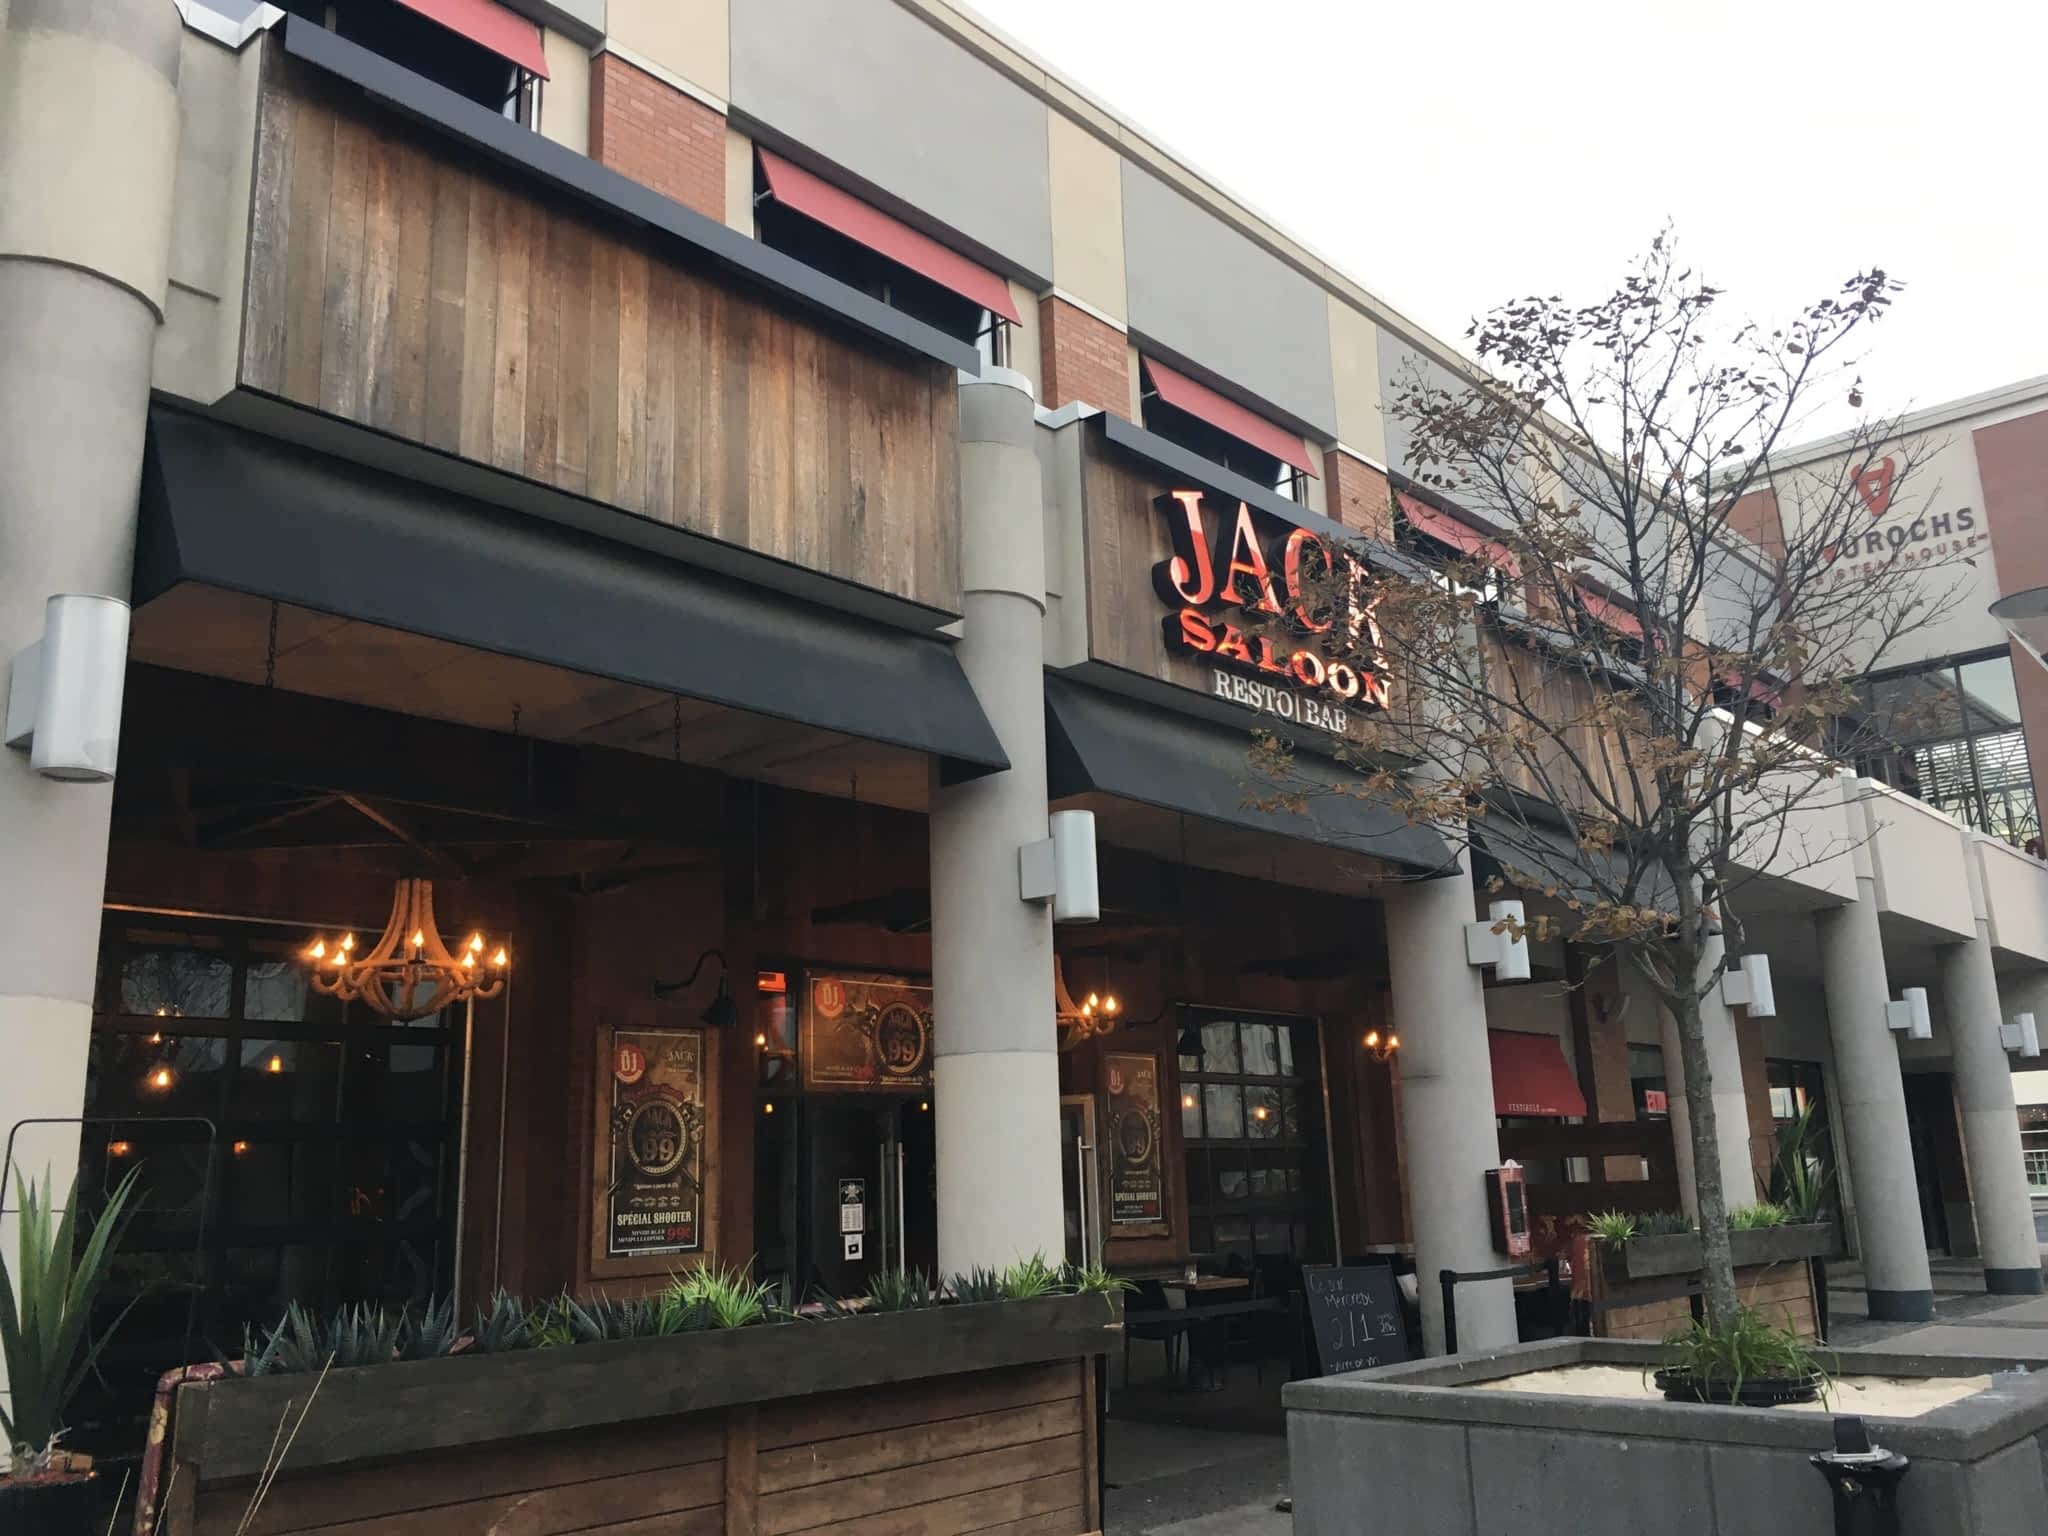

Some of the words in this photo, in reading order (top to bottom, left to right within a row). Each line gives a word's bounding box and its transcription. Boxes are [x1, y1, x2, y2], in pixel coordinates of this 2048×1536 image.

[1168, 490, 1391, 675] JACK
[1178, 607, 1390, 711] SALOON
[1212, 668, 1294, 719] RESTO
[1304, 699, 1349, 734] BAR
[653, 1211, 692, 1225] SHOOTER
